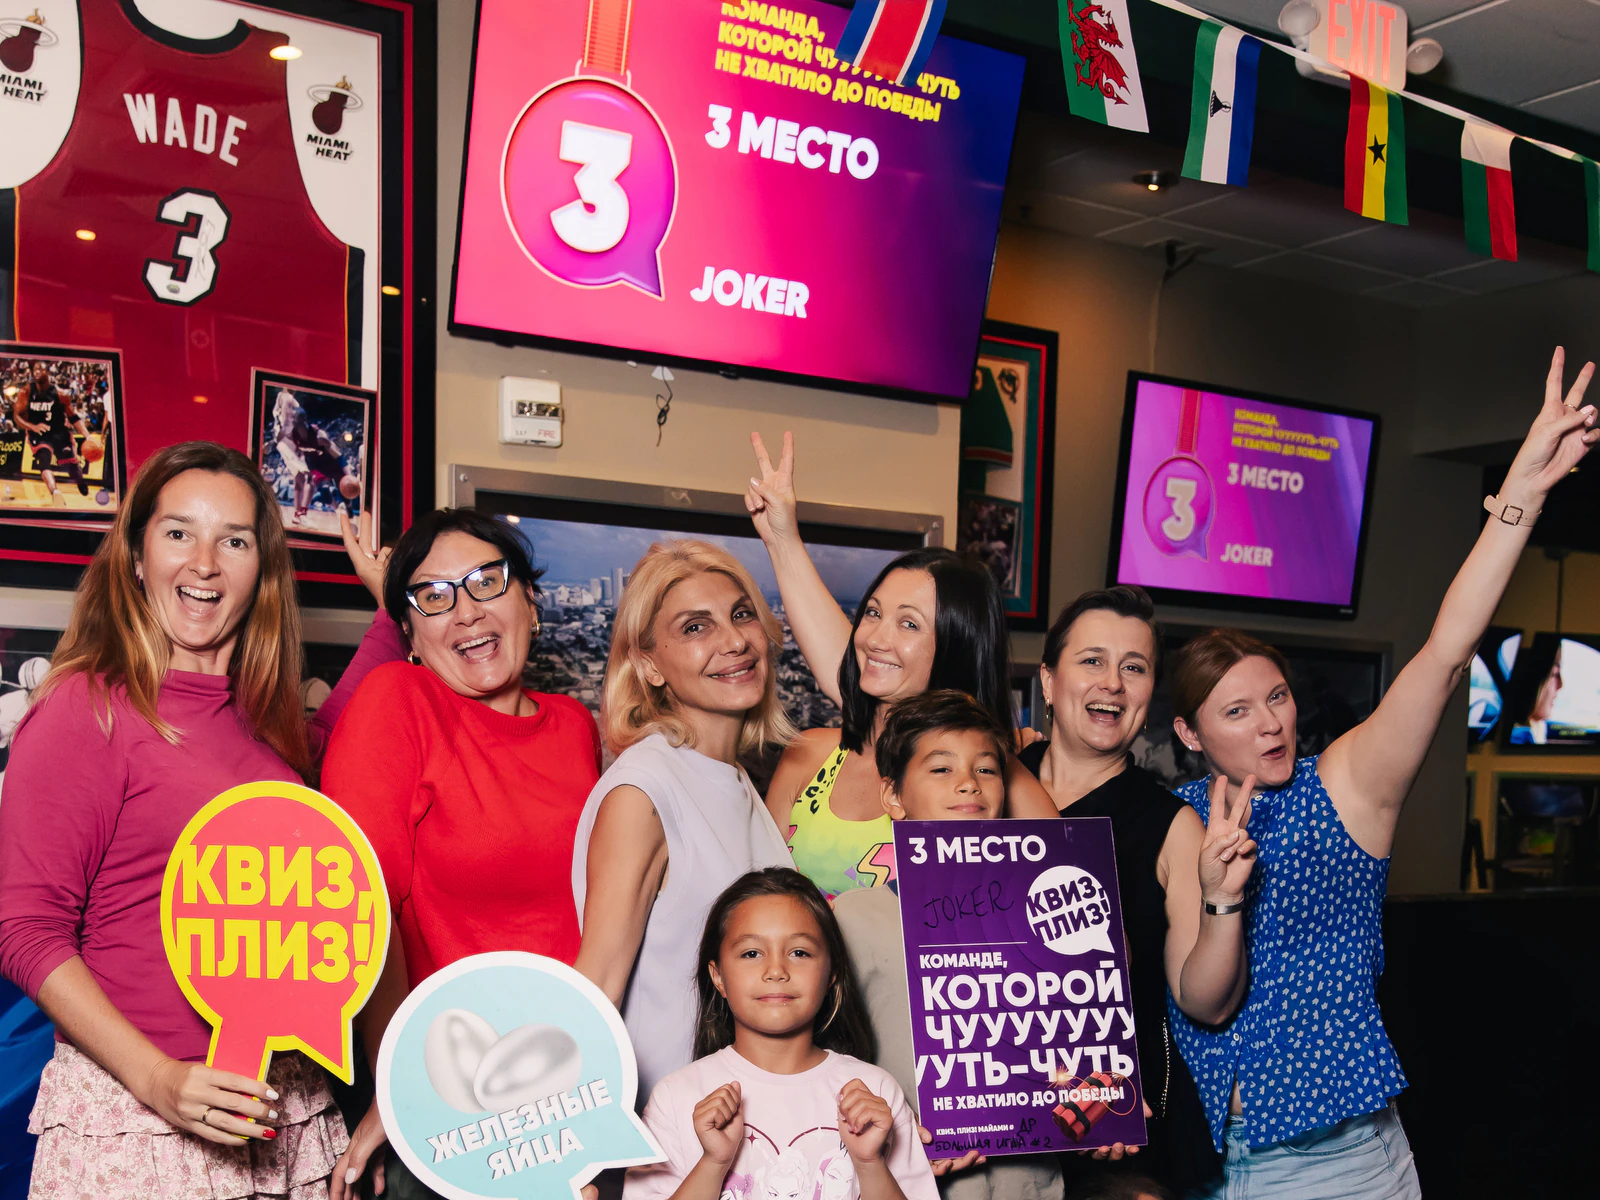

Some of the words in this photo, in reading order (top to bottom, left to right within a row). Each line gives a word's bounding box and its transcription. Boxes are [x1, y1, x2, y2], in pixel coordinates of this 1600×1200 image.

[718, 21, 813, 63] КОТОРОЙ
[1327, 0, 1396, 83] EXIT
[4, 86, 46, 102] HEAT
[715, 49, 741, 74] НЕ
[742, 55, 833, 96] ХВАТИЛО
[832, 79, 863, 104] ДО
[864, 86, 941, 122] ПОБЕДЫ
[123, 92, 248, 167] WADE
[306, 134, 349, 150] MIAMI
[704, 103, 732, 149] 3
[738, 111, 879, 180] МЕСТО
[316, 147, 353, 161] HEAT
[549, 119, 633, 253] 3
[142, 187, 232, 307] 3
[689, 266, 810, 319] JOKER
[30, 400, 54, 411] HEAT
[45, 411, 52, 421] 3
[1226, 462, 1240, 485] 3
[1240, 463, 1304, 494] МЕСТО
[1161, 477, 1199, 542] 3
[1220, 543, 1274, 567] JOKER
[909, 837, 926, 865] 3
[937, 834, 1047, 864] МЕСТО
[181, 844, 374, 921] КВИЗ,
[924, 881, 1014, 928] JOKER
[1027, 876, 1105, 918] КВИЗ,
[1033, 899, 1111, 943] ПЛИЗ!
[176, 917, 371, 984] ПЛИЗ!
[919, 952, 1008, 970] КОМАНДЕ,
[922, 960, 1124, 1011] КОТОРОЙ
[425, 1078, 613, 1164] ЖЕЛЕЗНЫЕ
[933, 1097, 953, 1111] НЕ
[956, 1092, 1029, 1110] ХВАТИЛО
[1032, 1090, 1056, 1107] ДО
[1059, 1086, 1125, 1103] ПОБЕДЫ
[486, 1126, 585, 1181] ЯЙЦА
